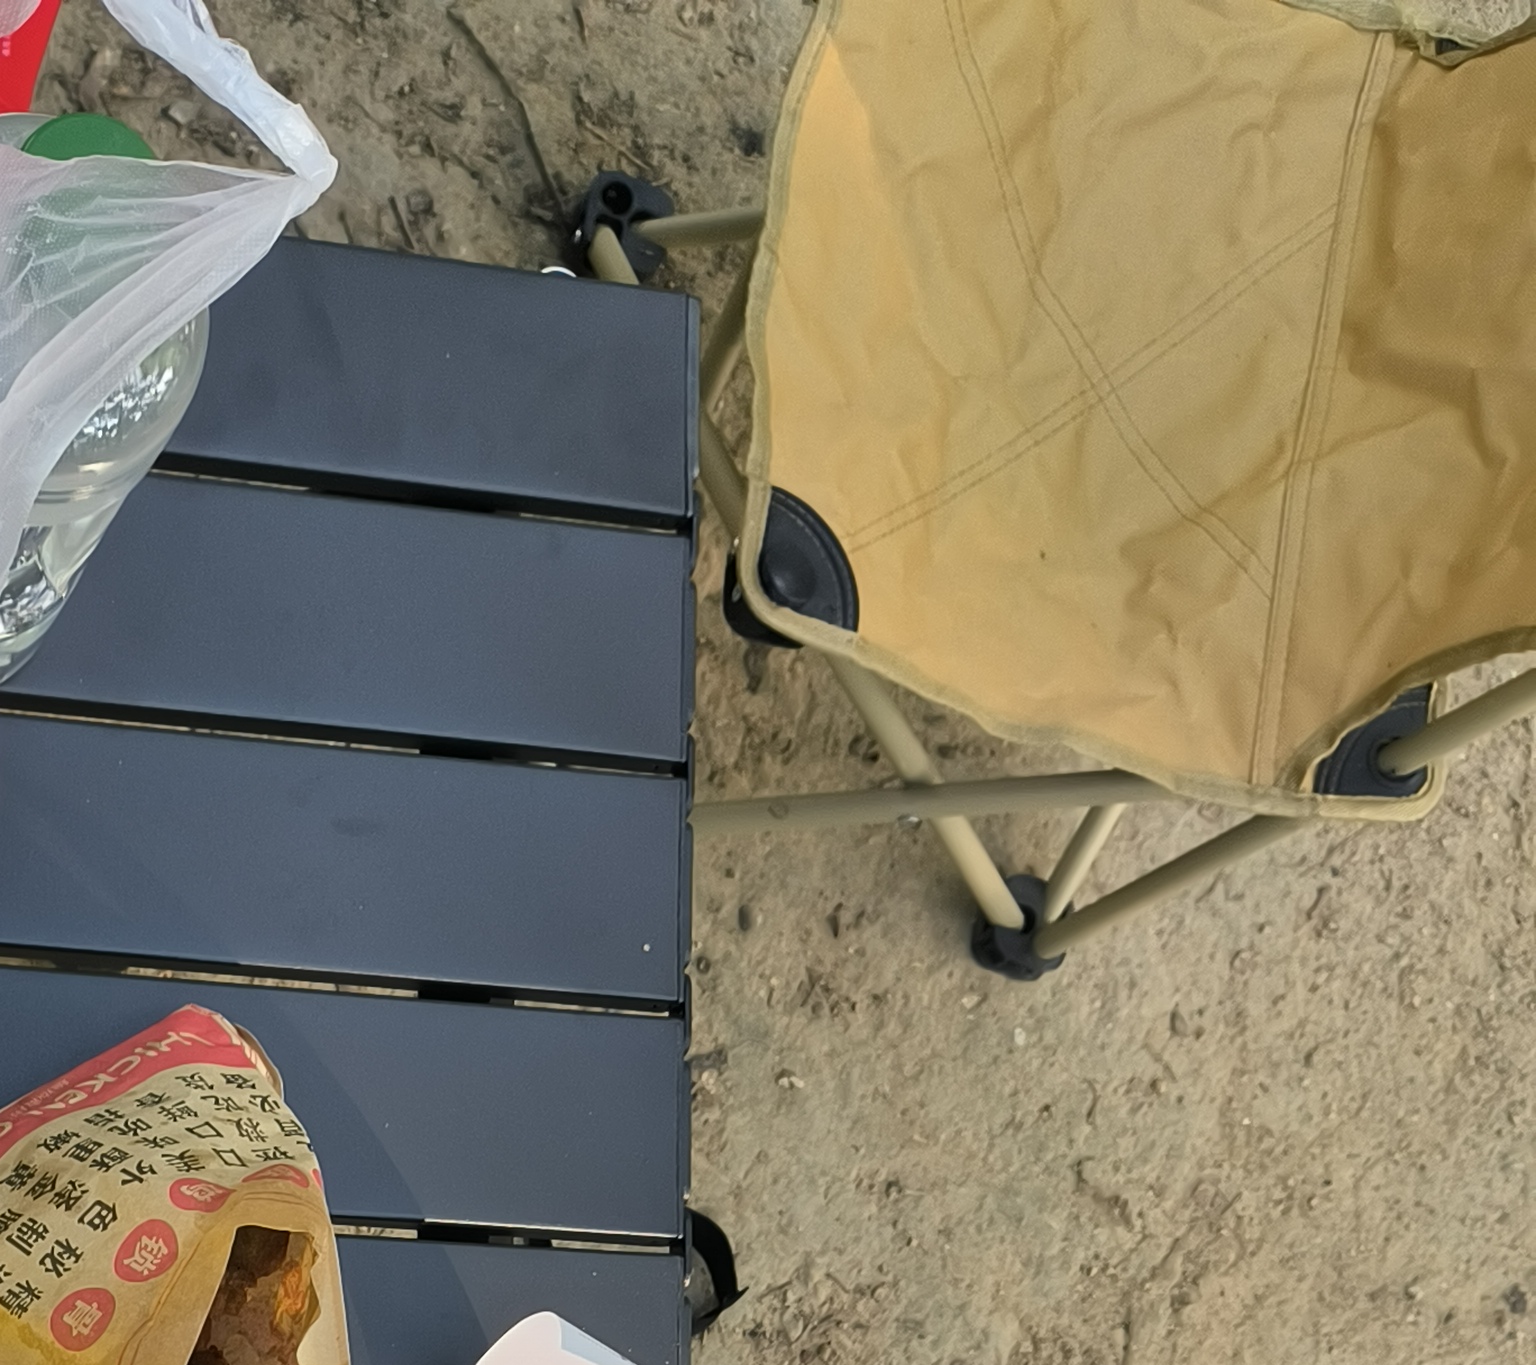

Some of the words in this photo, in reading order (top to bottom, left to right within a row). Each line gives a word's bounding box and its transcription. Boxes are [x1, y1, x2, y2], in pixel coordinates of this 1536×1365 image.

[36, 1128, 158, 1187] 外酥里嫩
[82, 1107, 206, 1174] 美味吮指
[133, 1090, 250, 1168] 口口鲜香
[0, 1159, 120, 1234] 色泽金黄
